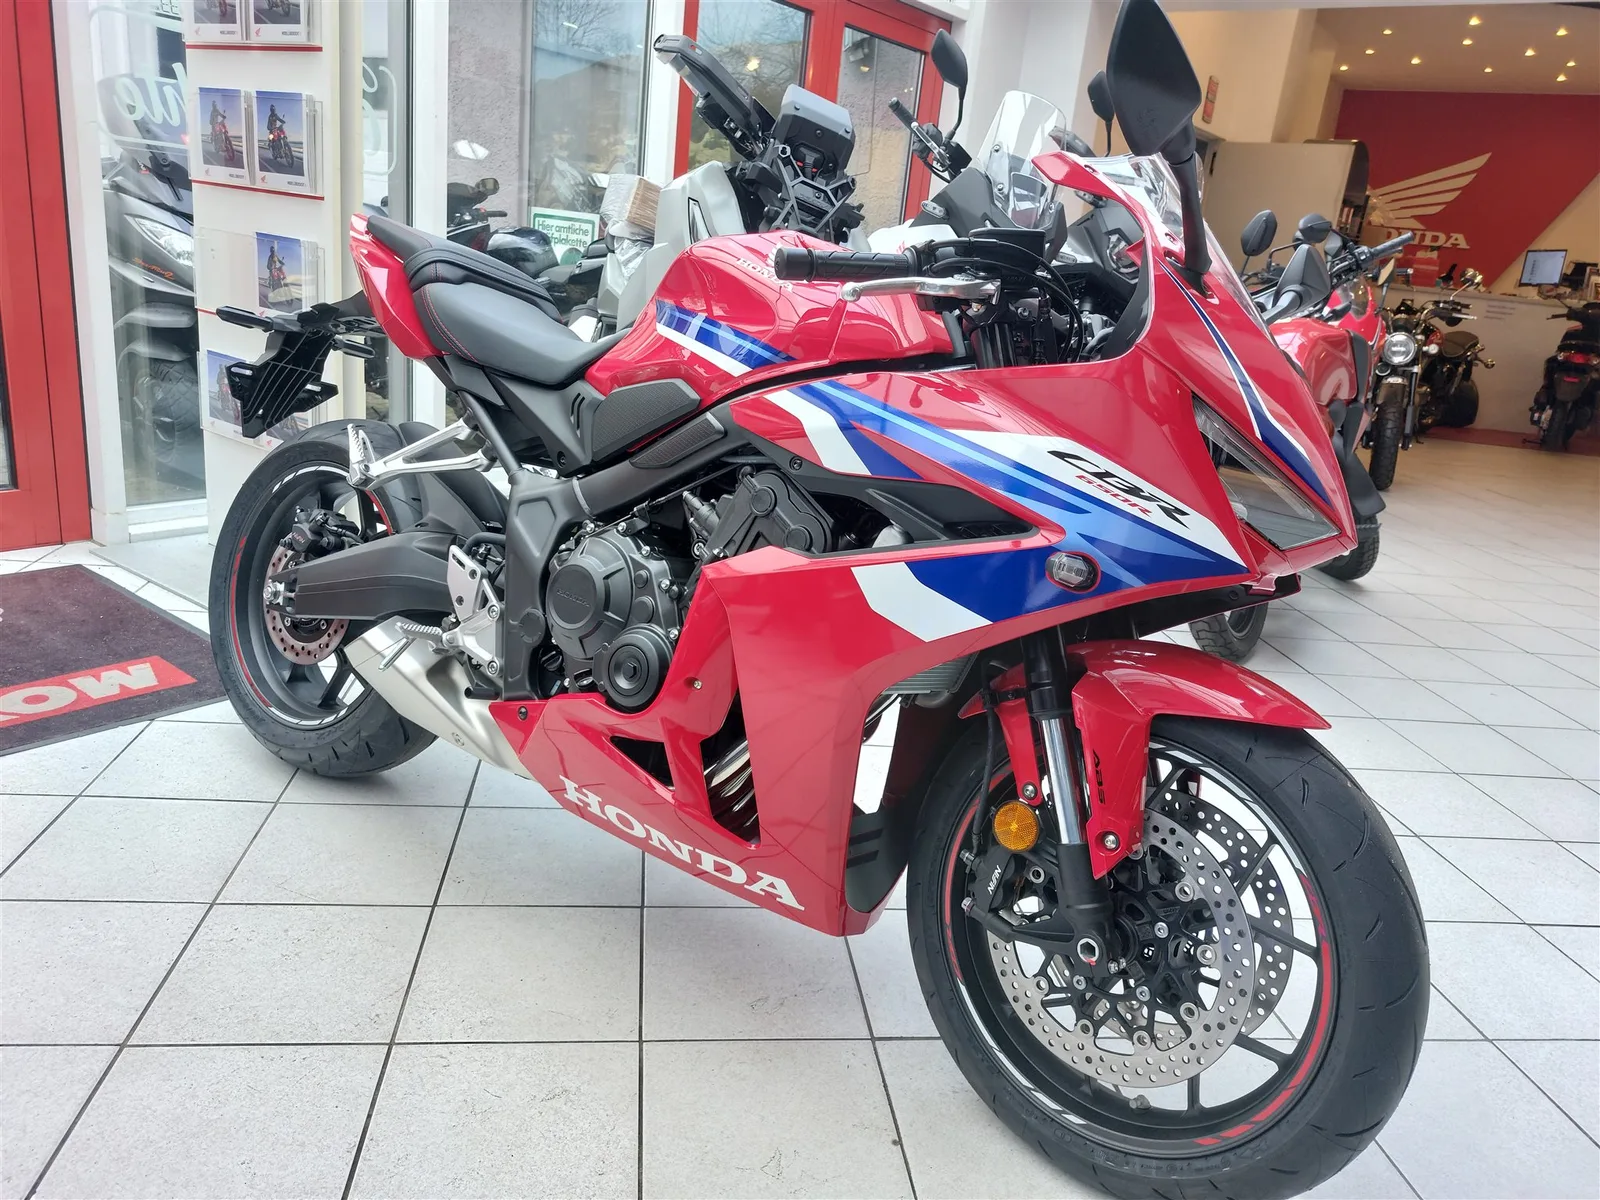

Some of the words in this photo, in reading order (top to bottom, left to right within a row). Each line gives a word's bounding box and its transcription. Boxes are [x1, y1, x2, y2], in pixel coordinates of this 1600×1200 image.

[537, 219, 554, 232] Hier
[554, 223, 590, 237] amtliche
[1047, 450, 1191, 530] CBR
[1075, 474, 1153, 518] 650R
[559, 774, 805, 911] HONDA
